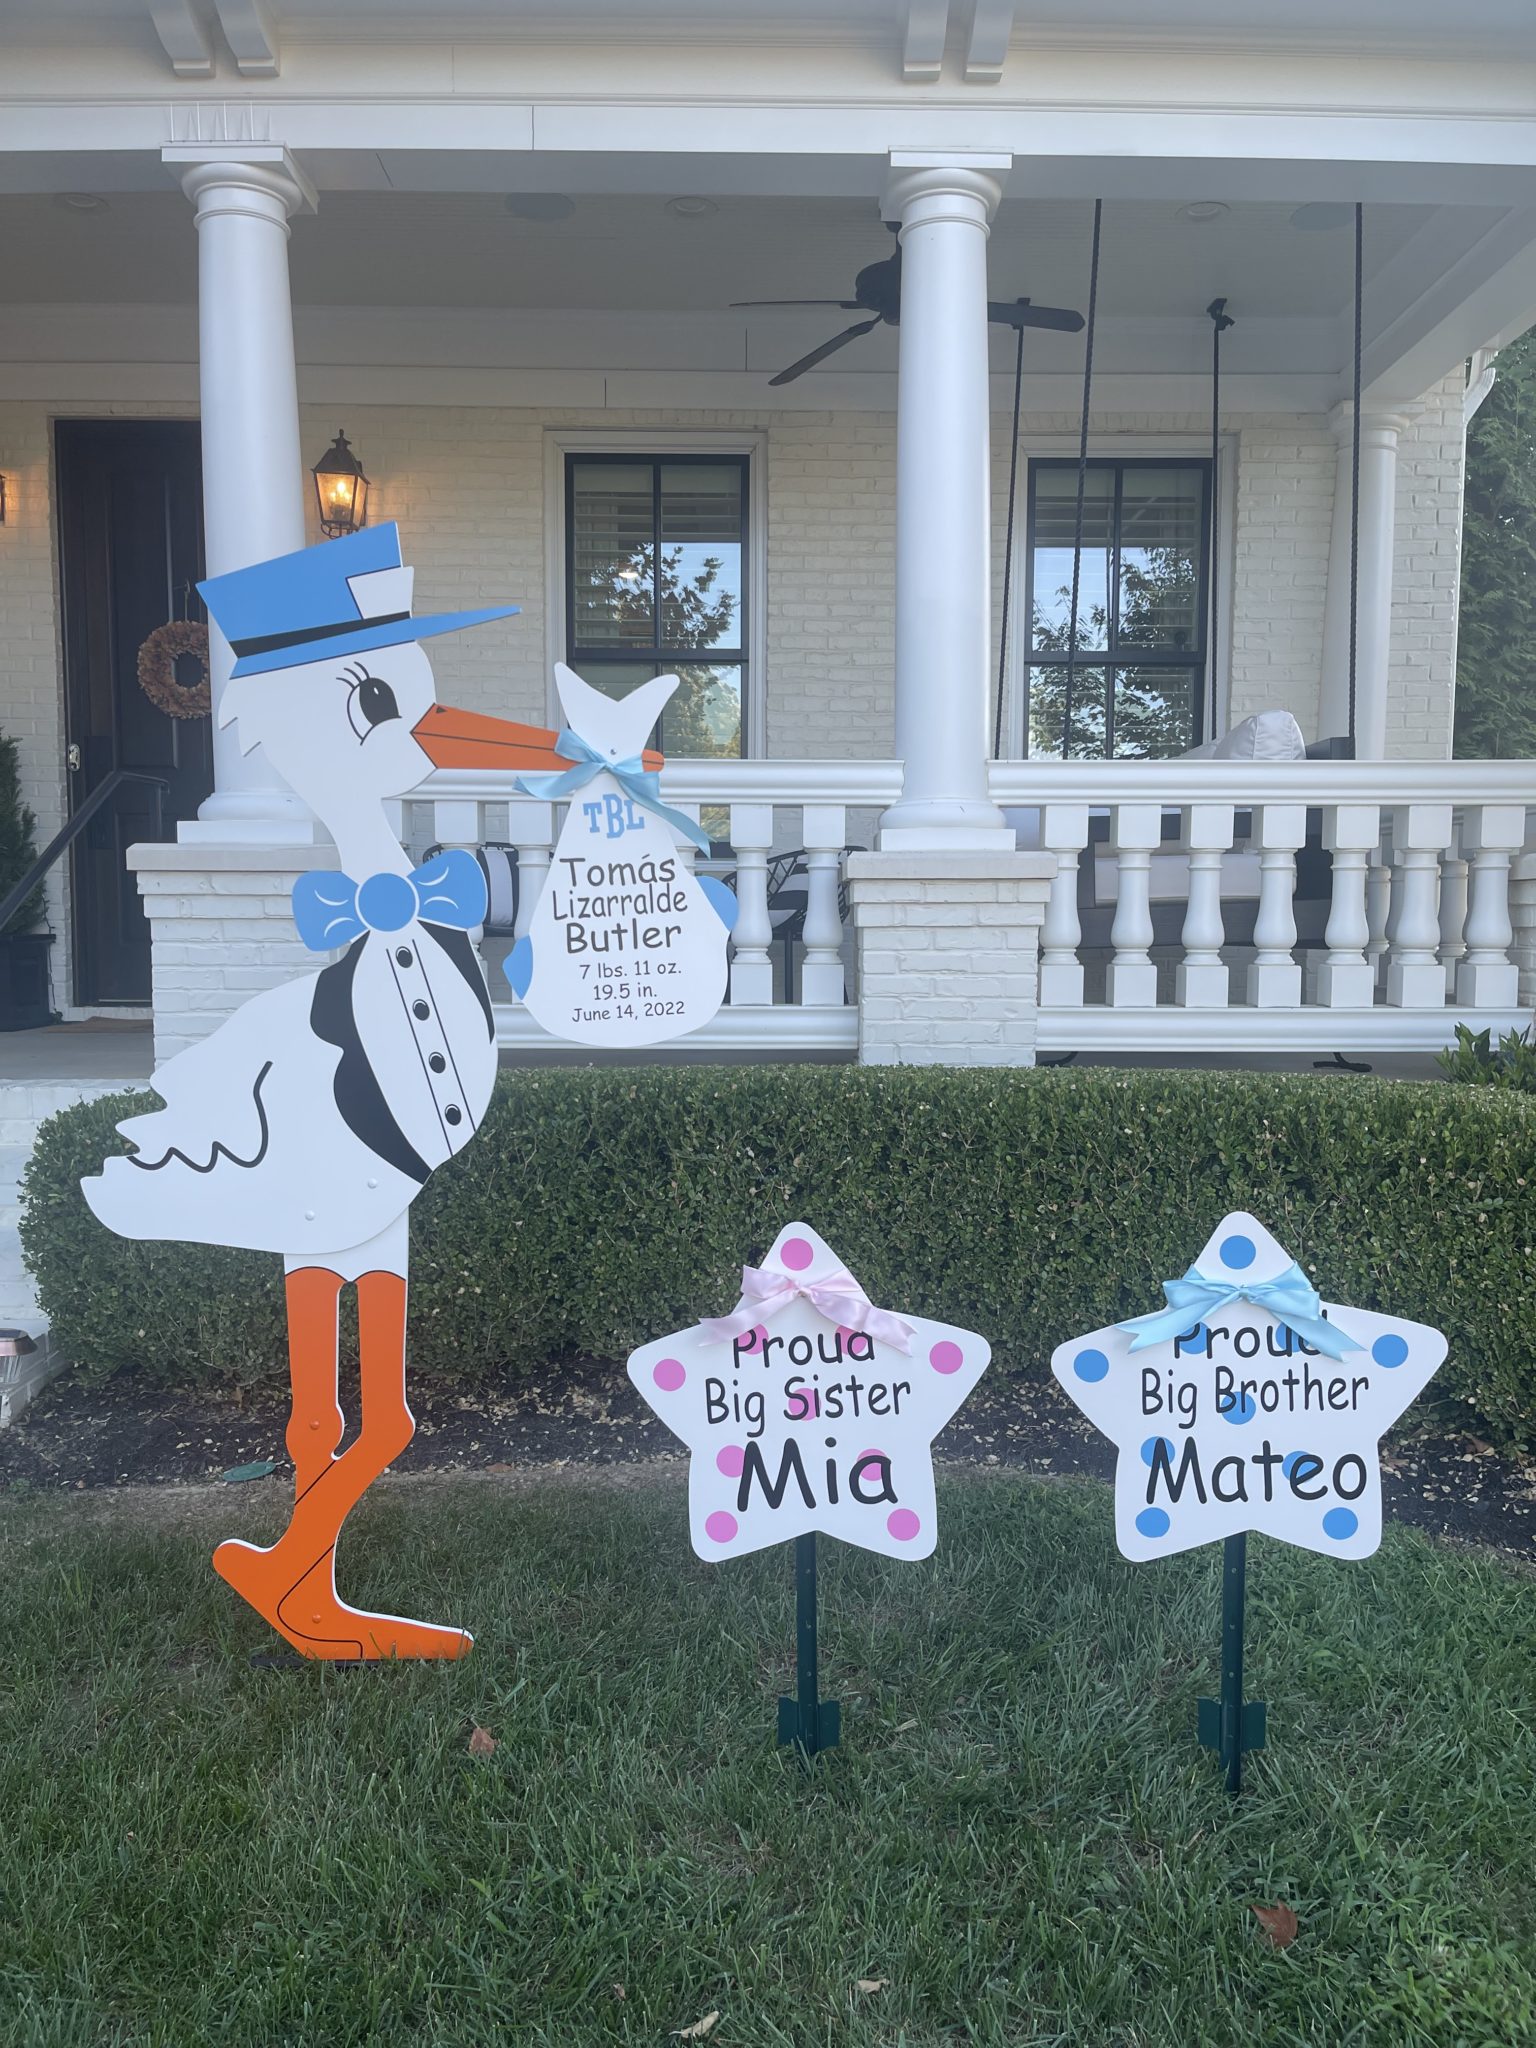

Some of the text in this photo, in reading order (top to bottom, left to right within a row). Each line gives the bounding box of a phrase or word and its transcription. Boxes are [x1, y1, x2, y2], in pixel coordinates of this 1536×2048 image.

[583, 793, 645, 838] TBL
[559, 854, 676, 887] Tomás
[552, 882, 688, 921] Lizarralde
[566, 918, 682, 954] Butler
[579, 960, 682, 980] 7 lbs. 11 oz.
[593, 983, 657, 1000] 19.5 in.
[571, 1001, 686, 1023] June 14, 2022
[705, 1374, 911, 1438] Big Sister
[1141, 1362, 1369, 1430] Big Brother
[736, 1436, 899, 1513] Mia
[1145, 1436, 1368, 1505] Mateo
